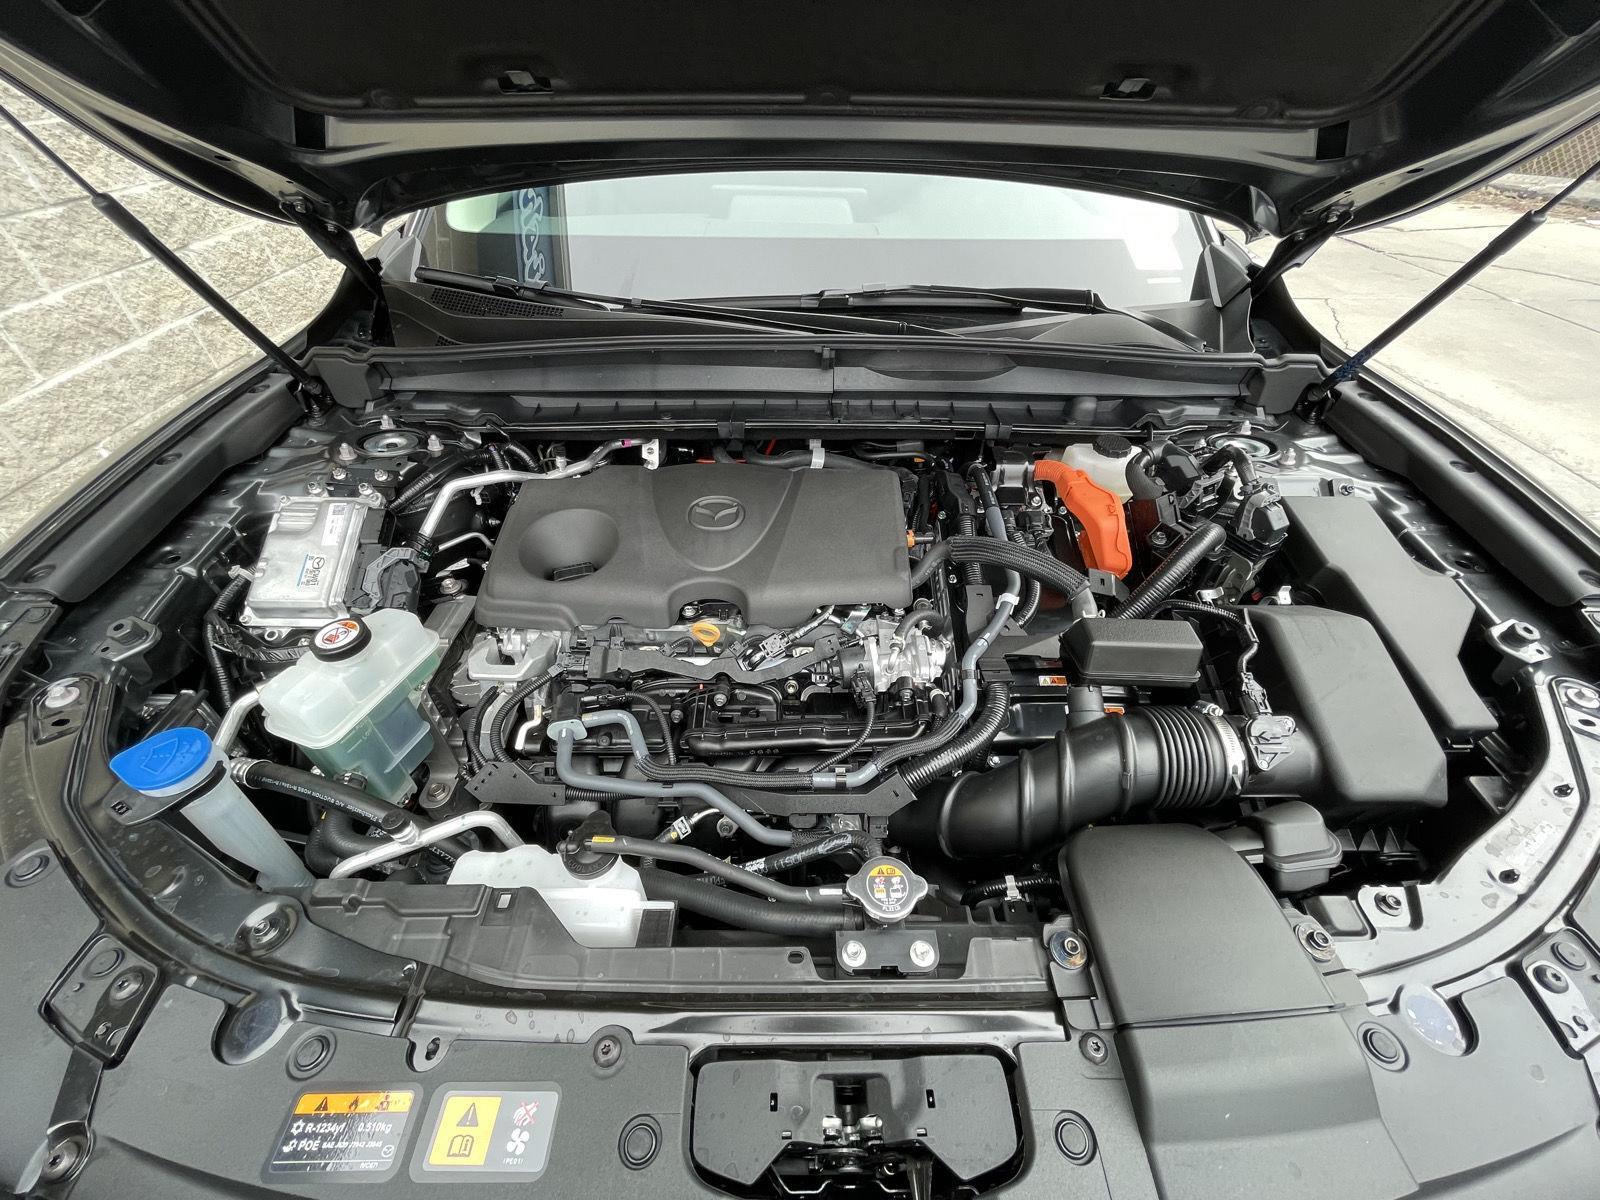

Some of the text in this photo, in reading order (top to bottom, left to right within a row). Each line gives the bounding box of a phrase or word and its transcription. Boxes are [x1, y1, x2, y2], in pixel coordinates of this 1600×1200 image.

[297, 786, 312, 795] HOSE
[311, 790, 335, 804] SUCTION
[334, 799, 345, 807] A/C
[357, 1122, 393, 1134] 0.510kg
[297, 1139, 321, 1151] POE
